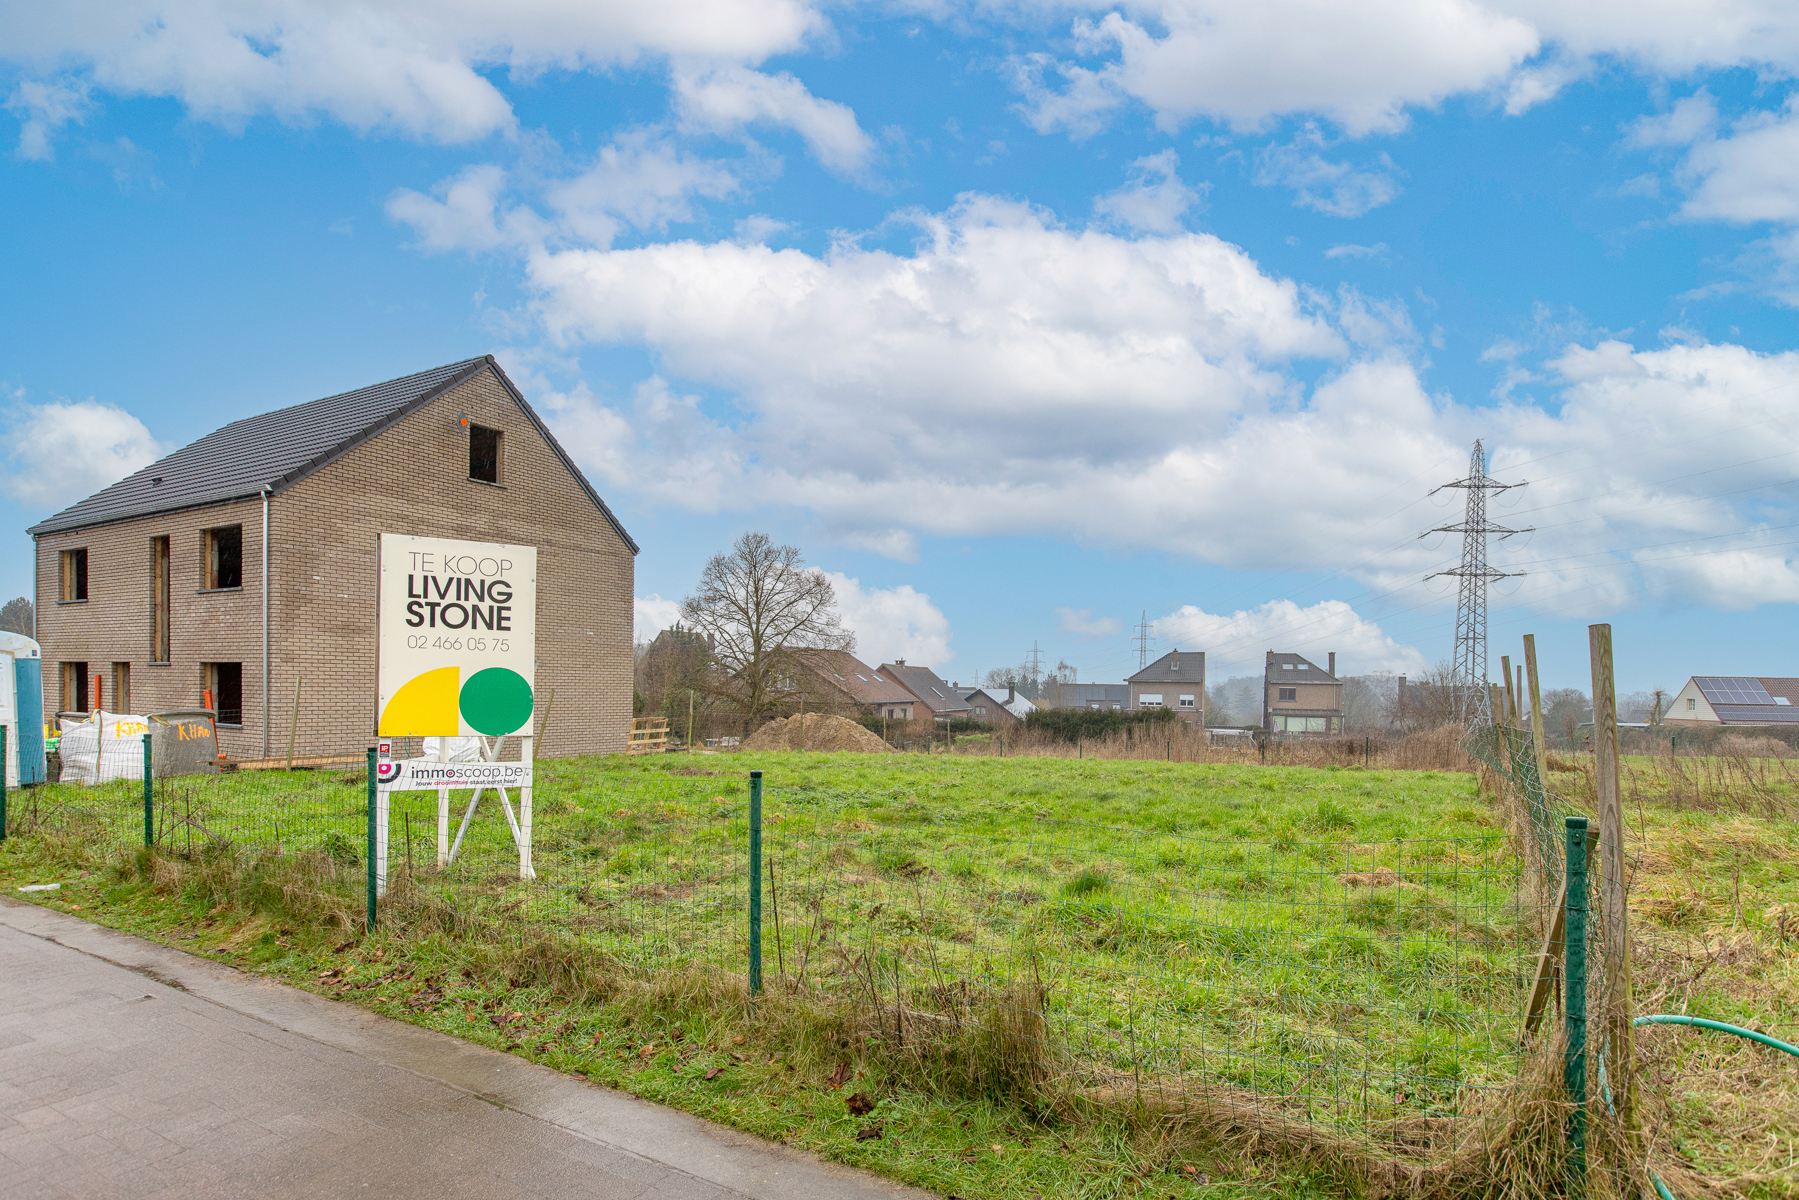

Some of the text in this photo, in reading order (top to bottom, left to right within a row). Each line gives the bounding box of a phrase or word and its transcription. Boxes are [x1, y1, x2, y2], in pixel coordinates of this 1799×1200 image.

[408, 551, 513, 577] TE KOOP
[407, 574, 513, 604] LIVING
[405, 600, 512, 631] STONE
[407, 634, 510, 652] 02 466 05 75
[411, 766, 523, 779] immoscoop.be
